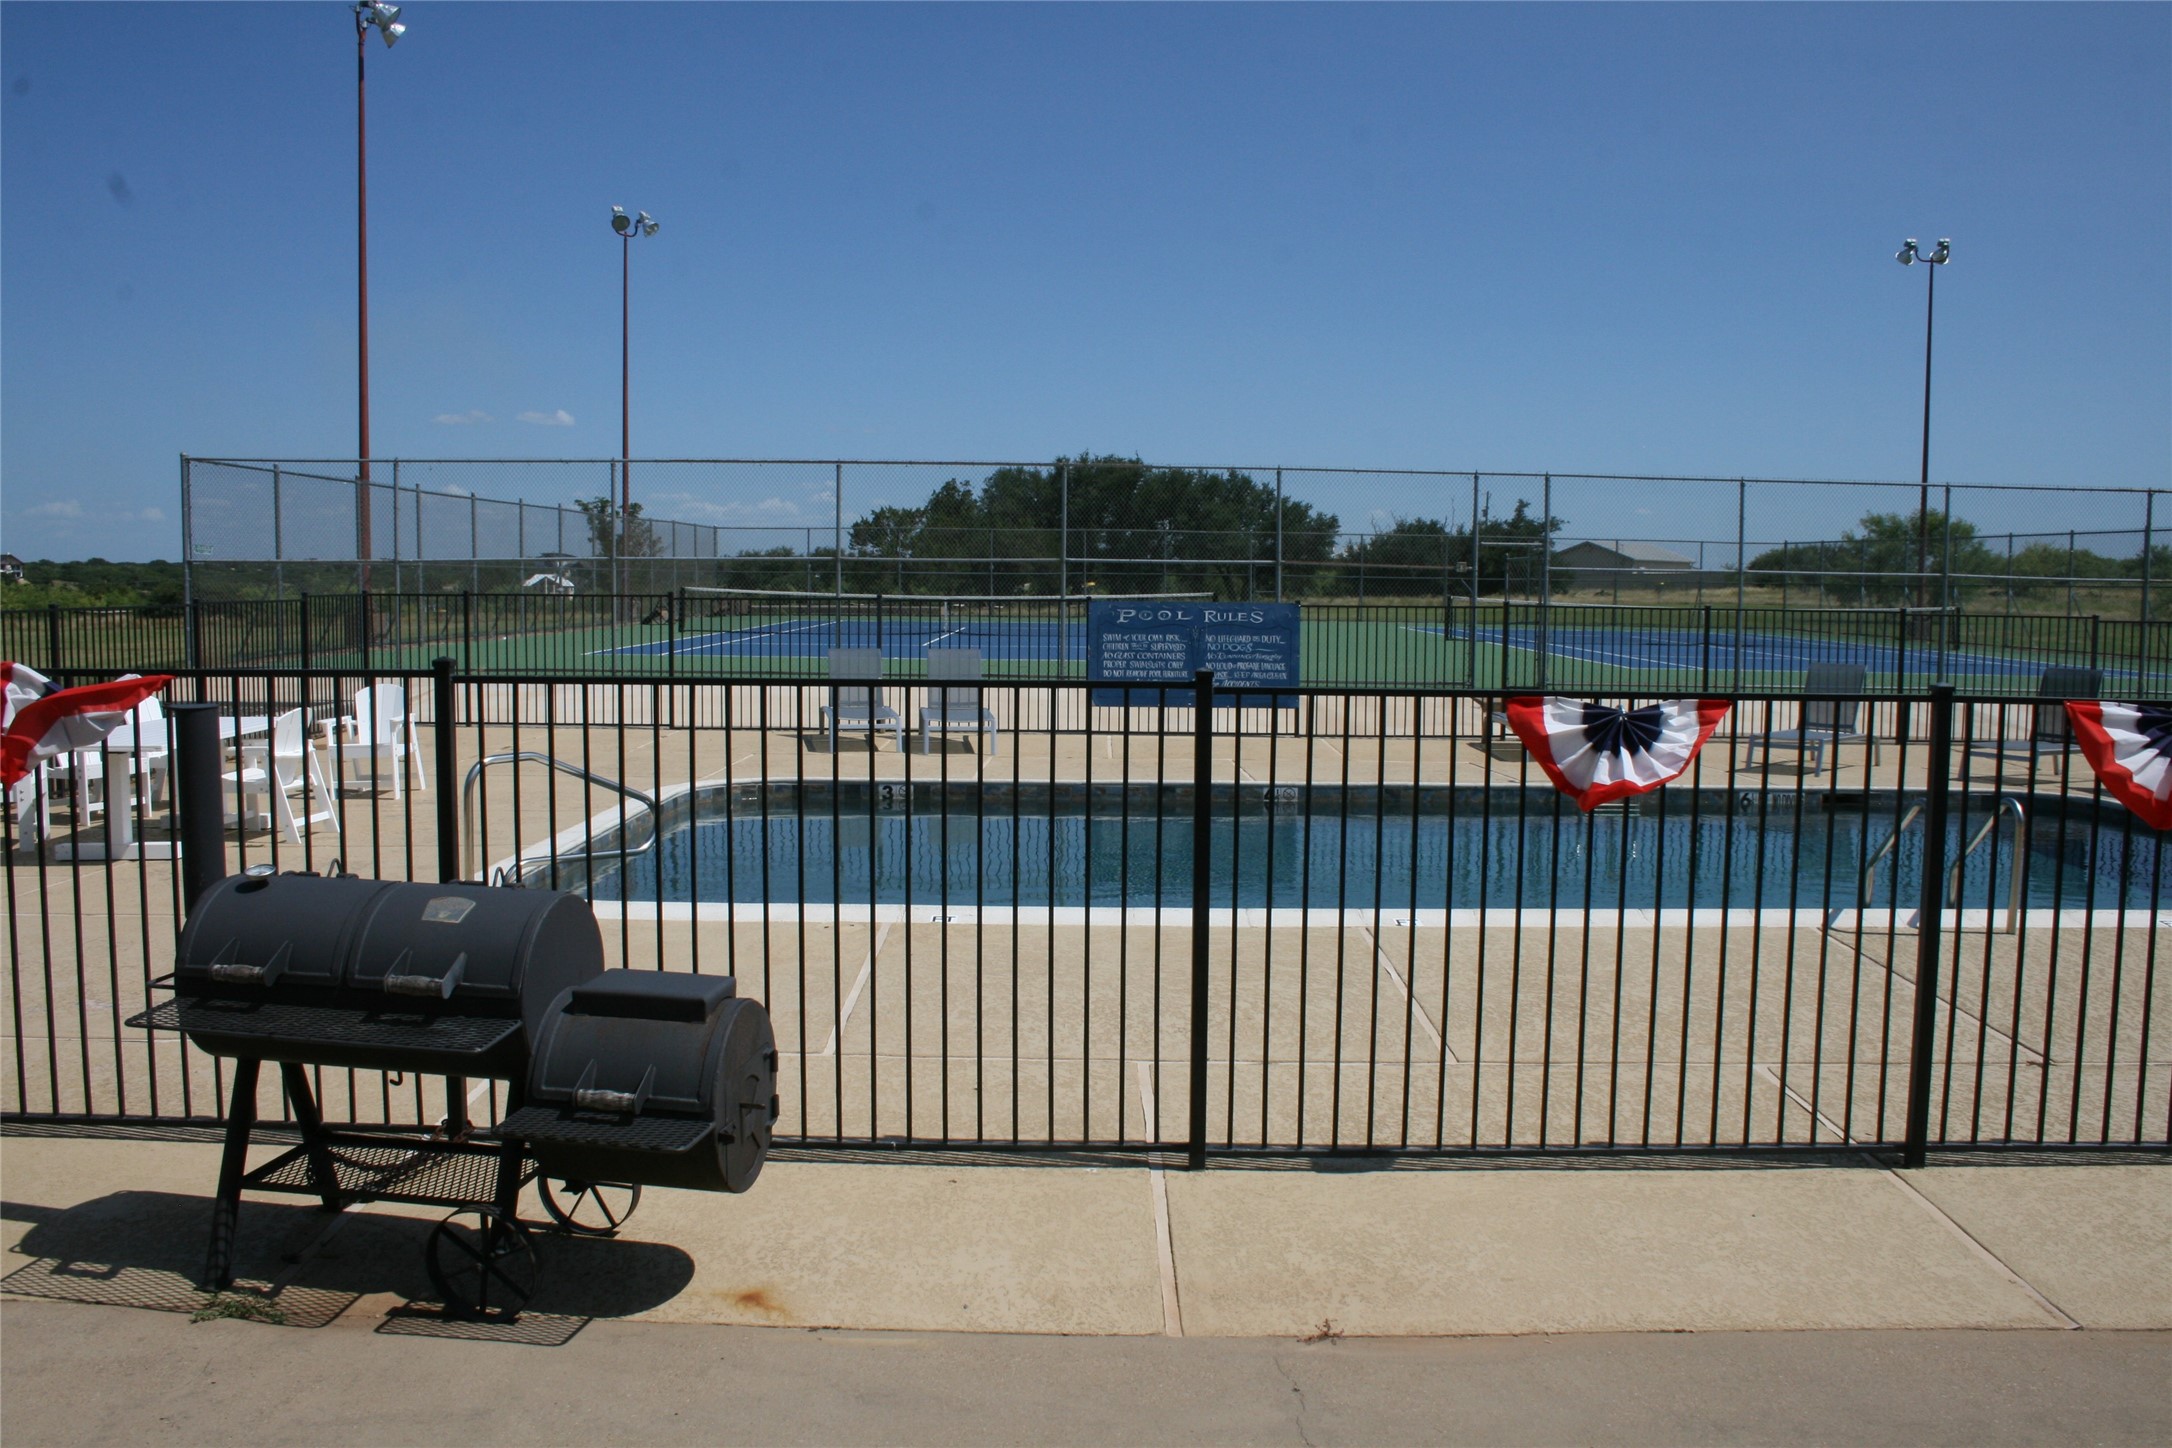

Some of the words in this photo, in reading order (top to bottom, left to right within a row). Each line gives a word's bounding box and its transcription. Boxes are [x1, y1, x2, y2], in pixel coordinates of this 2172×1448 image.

[1116, 609, 1194, 624] POOL
[1203, 609, 1264, 624] RULES
[1103, 634, 1121, 642] SWIM
[1205, 633, 1217, 643] NO
[1217, 634, 1251, 643] LIFEGUARD
[1261, 634, 1281, 643] DUTY
[1206, 642, 1221, 651] NO
[1222, 642, 1253, 653] DOGS
[1113, 652, 1136, 660] GLASS
[1136, 652, 1186, 661] CONTAINERS
[1103, 660, 1127, 669] PROPER
[1167, 661, 1185, 669] ONLY
[1205, 661, 1216, 670] NO
[1103, 669, 1113, 678] DO
[1113, 669, 1125, 678] NOT
